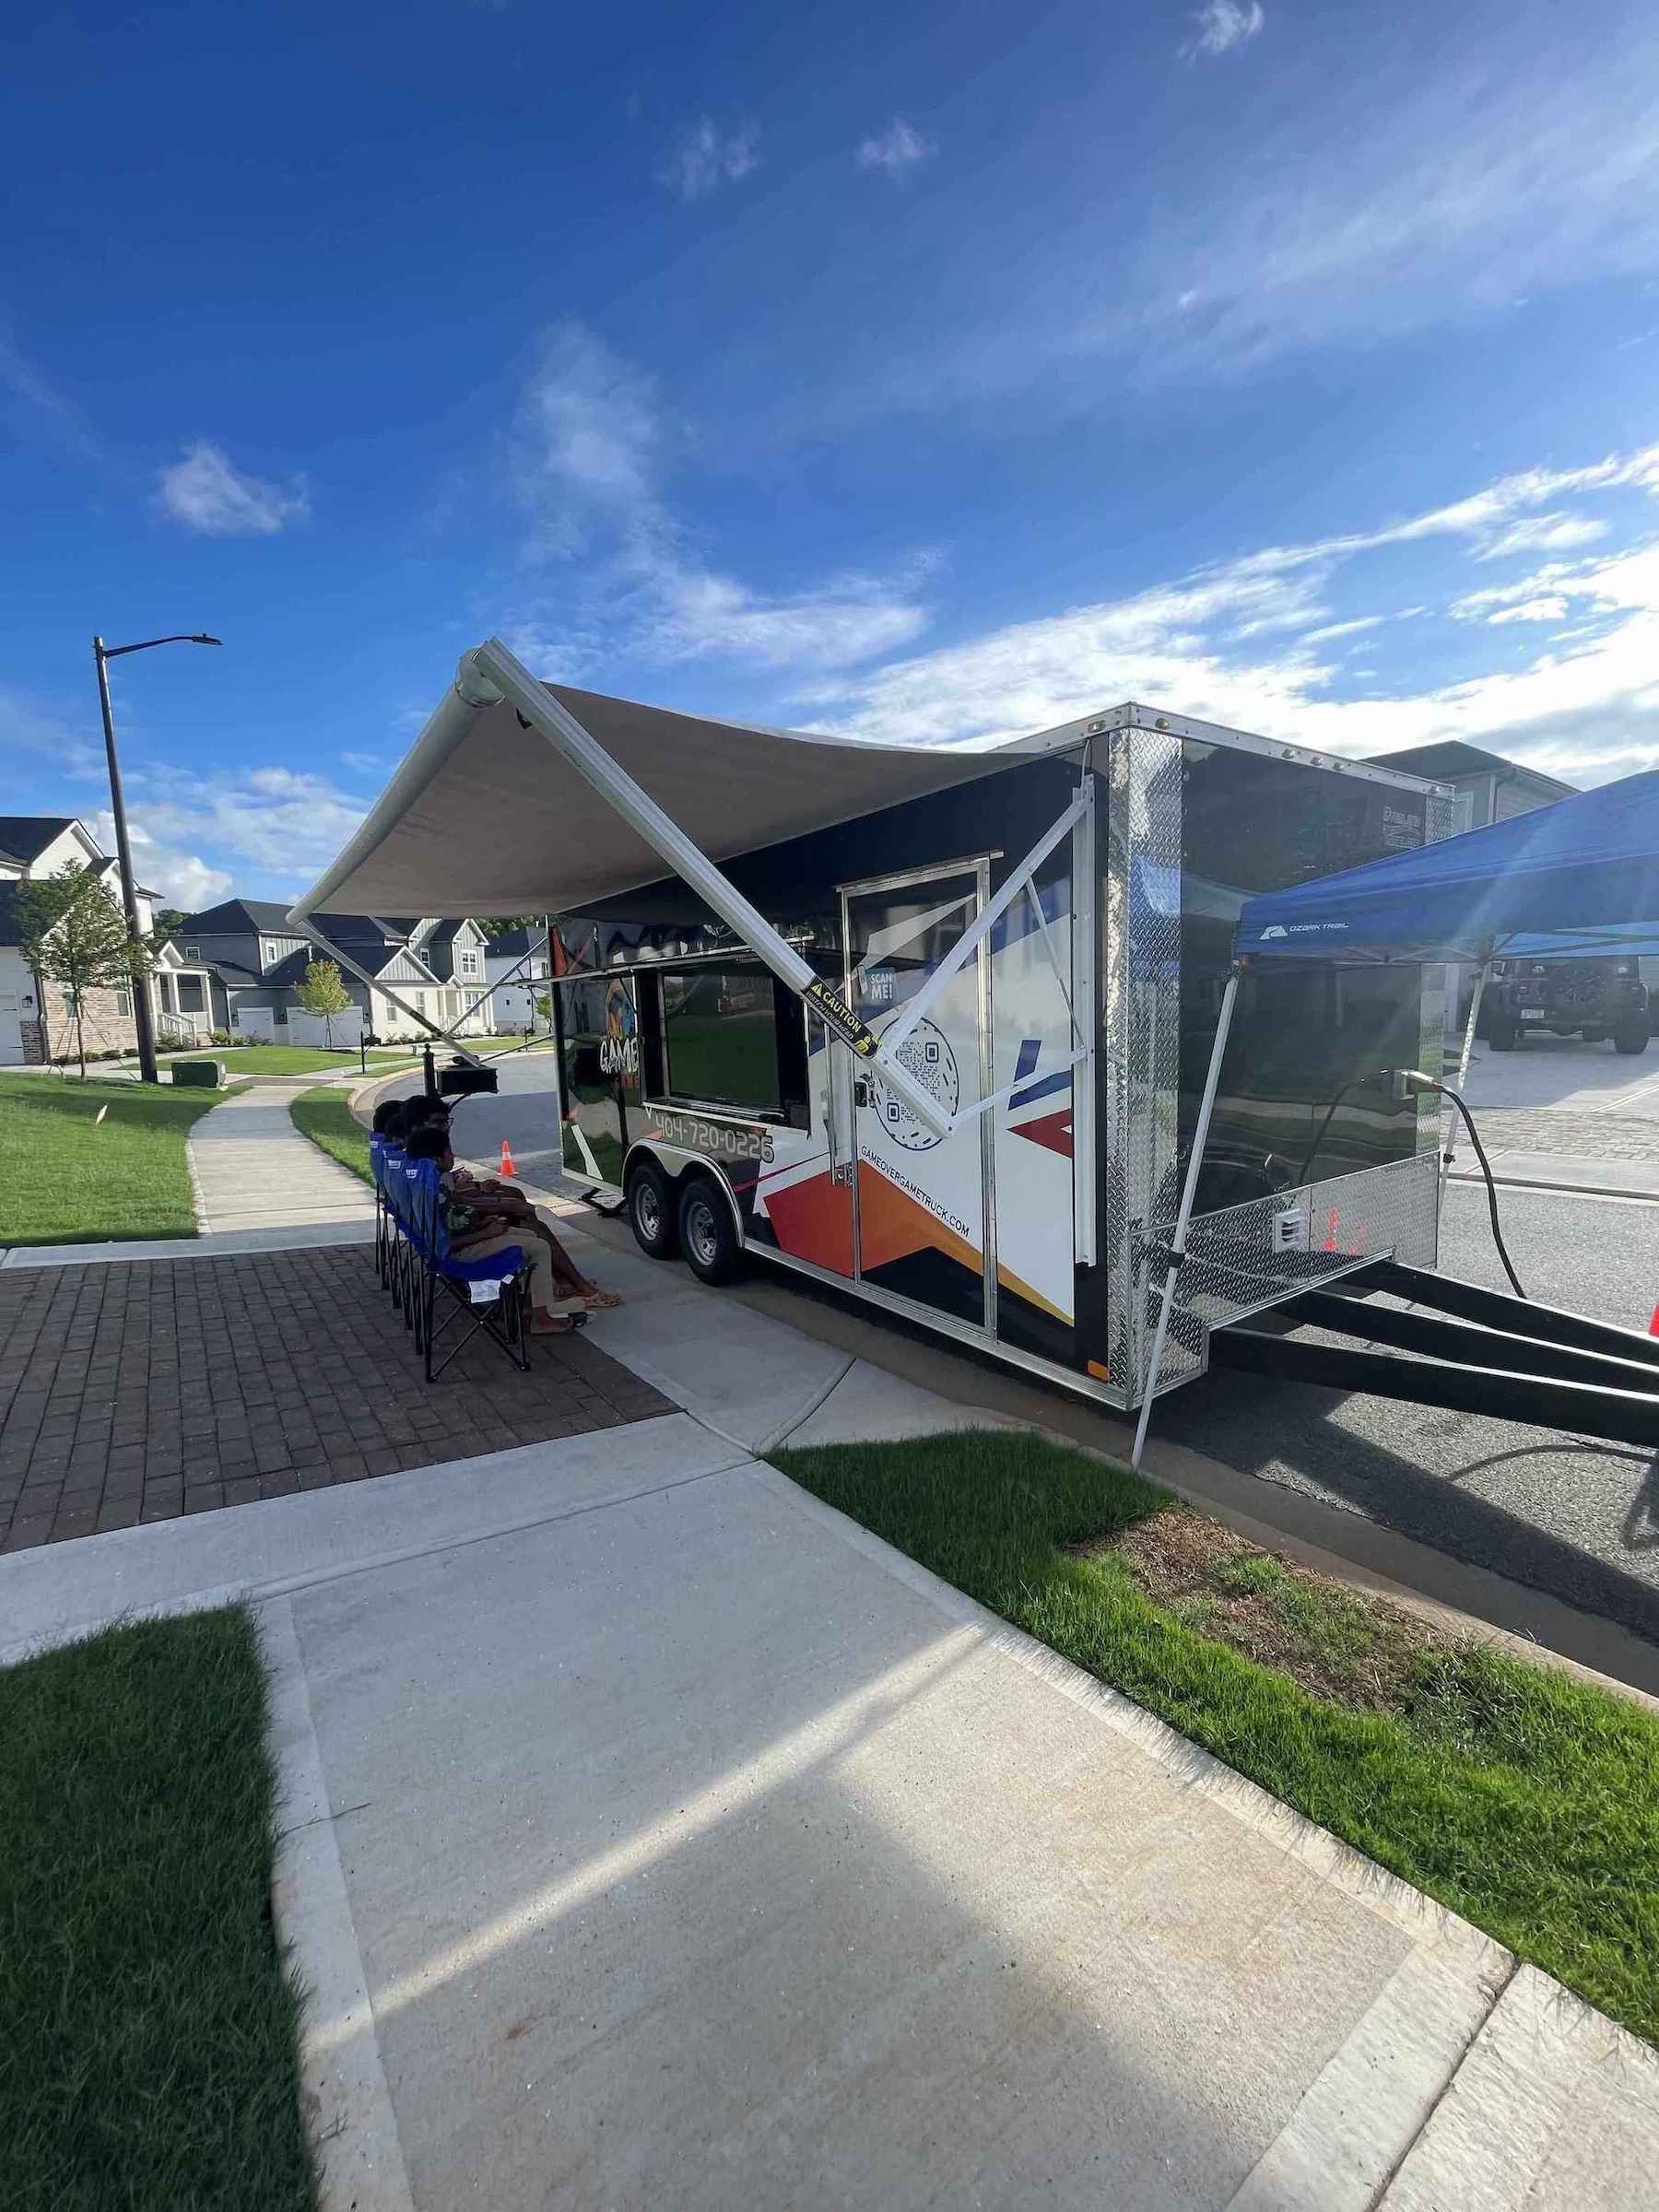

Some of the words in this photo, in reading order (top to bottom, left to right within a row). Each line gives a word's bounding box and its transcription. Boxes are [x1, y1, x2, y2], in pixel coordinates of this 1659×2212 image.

[870, 972, 892, 983] SCAN
[871, 983, 892, 1000] ME!
[822, 992, 862, 1032] CAUTION
[600, 1037, 639, 1074] GAME
[861, 1146, 970, 1238] GAMEOVERGAMETRUCK.COM
